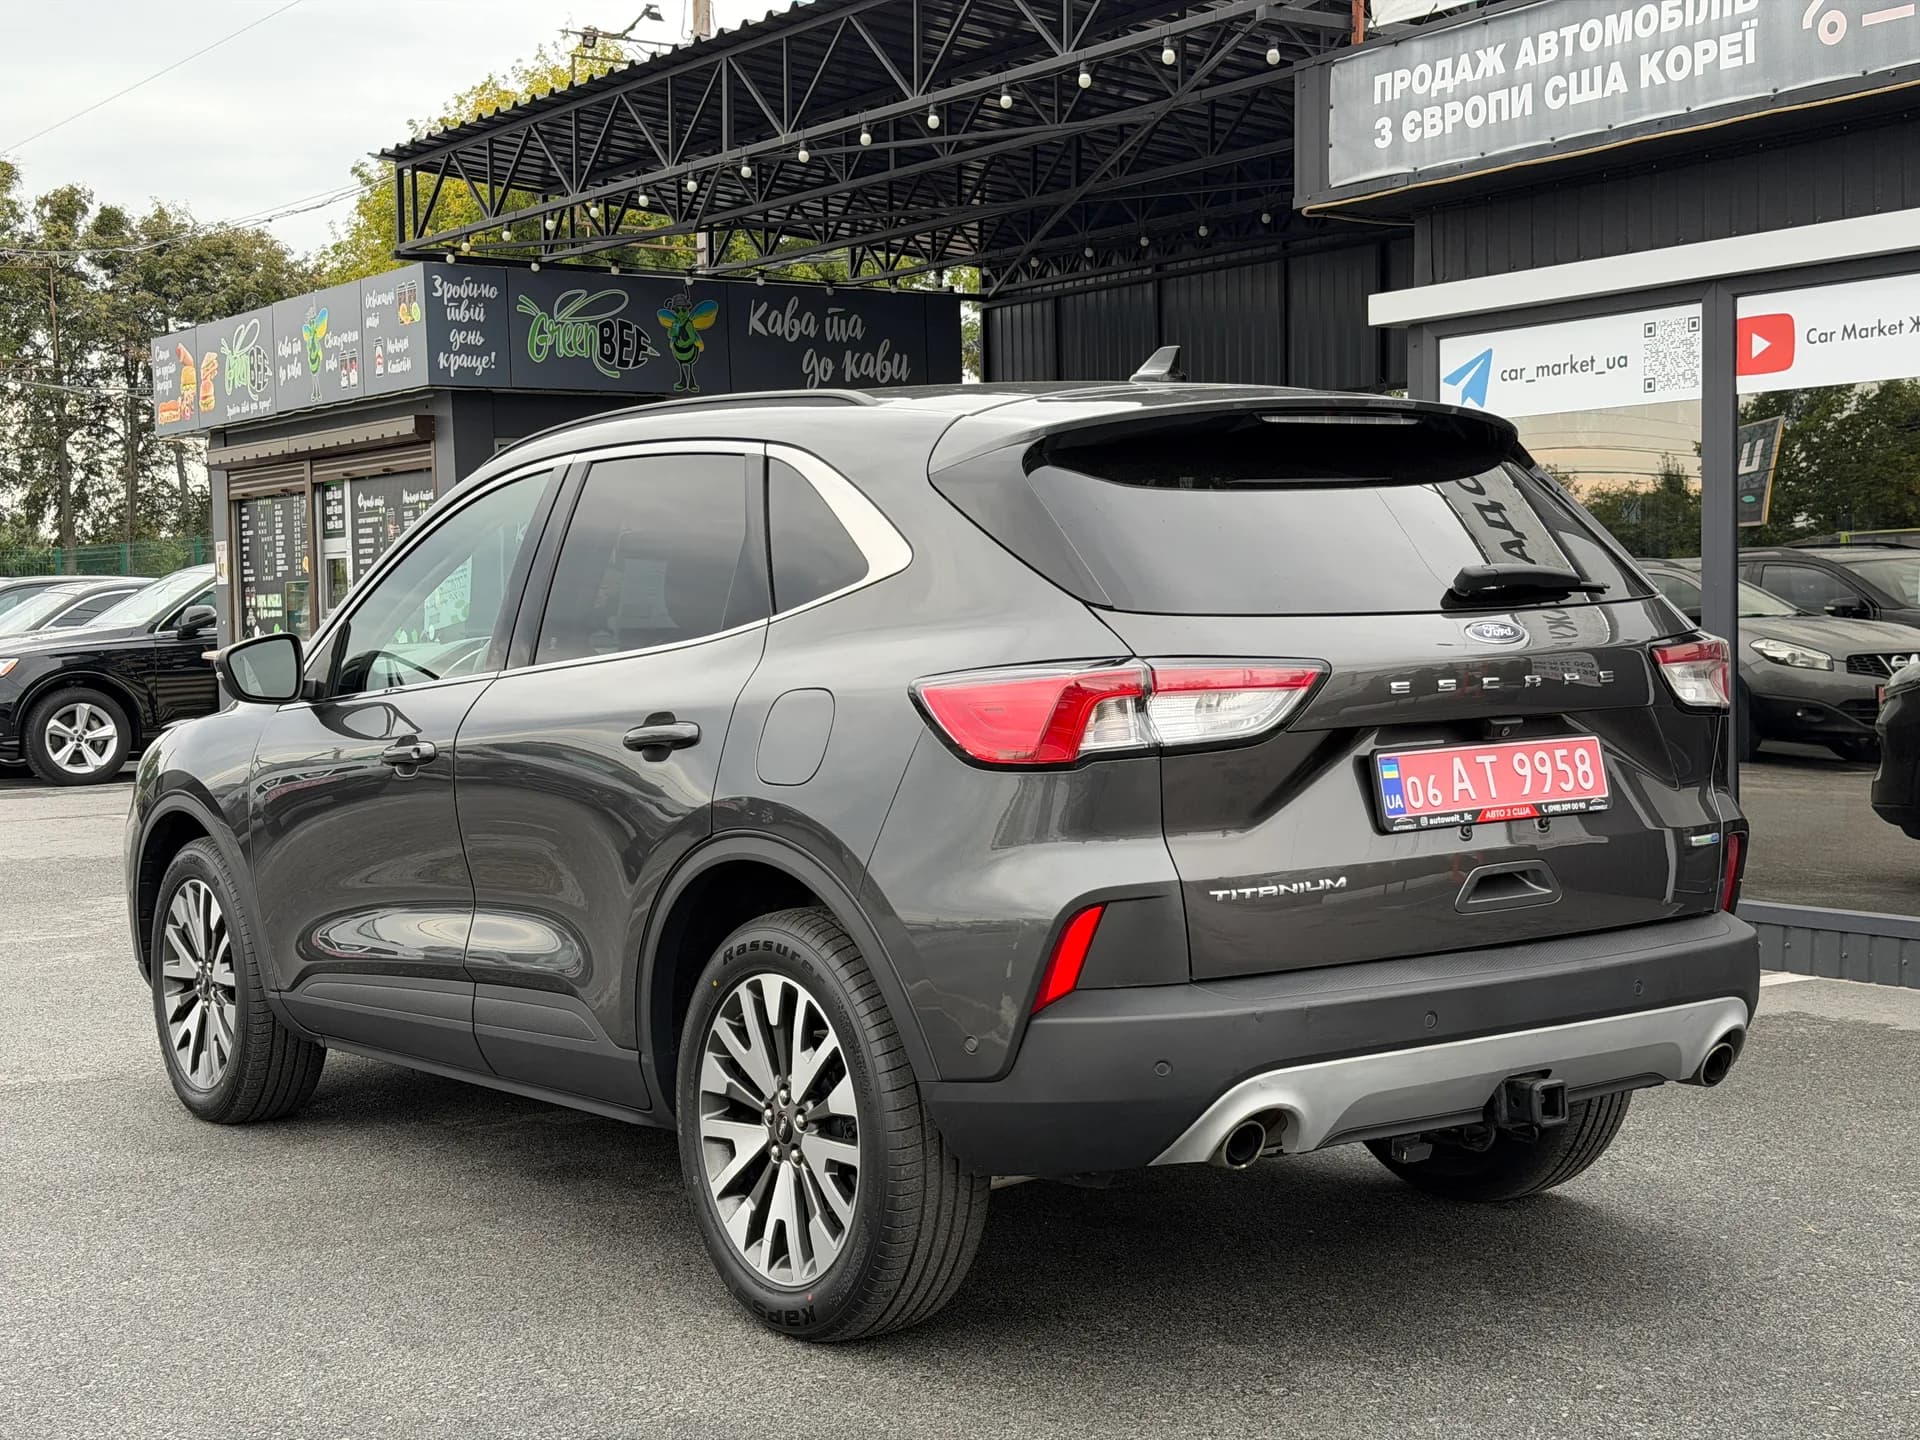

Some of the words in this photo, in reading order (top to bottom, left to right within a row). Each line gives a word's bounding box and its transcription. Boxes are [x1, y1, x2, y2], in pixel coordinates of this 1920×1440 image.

[1374, 43, 1507, 105] ПРОДАЖ
[1374, 116, 1393, 149] З
[1402, 83, 1533, 143] ЄВРОПИ
[1544, 61, 1629, 110] США
[1639, 18, 1759, 89] КОРЕЇ
[432, 275, 498, 305] Зробимо
[446, 298, 486, 323] твій
[748, 296, 820, 343] Кава
[825, 307, 866, 343] та
[449, 328, 485, 351] день
[1806, 328, 1836, 345] Car
[1841, 318, 1905, 341] Market
[437, 351, 496, 378] краще!
[802, 348, 835, 389] до
[842, 338, 911, 384] кави
[1500, 353, 1628, 383] car_market_ua
[1482, 624, 1514, 639] Ford
[1390, 670, 1615, 695] ESCAPE
[1405, 774, 1443, 809] 06
[1452, 754, 1499, 802] AT
[1511, 747, 1595, 796] 9958
[1386, 793, 1404, 810] UA
[1209, 876, 1347, 901] TITANIUM
